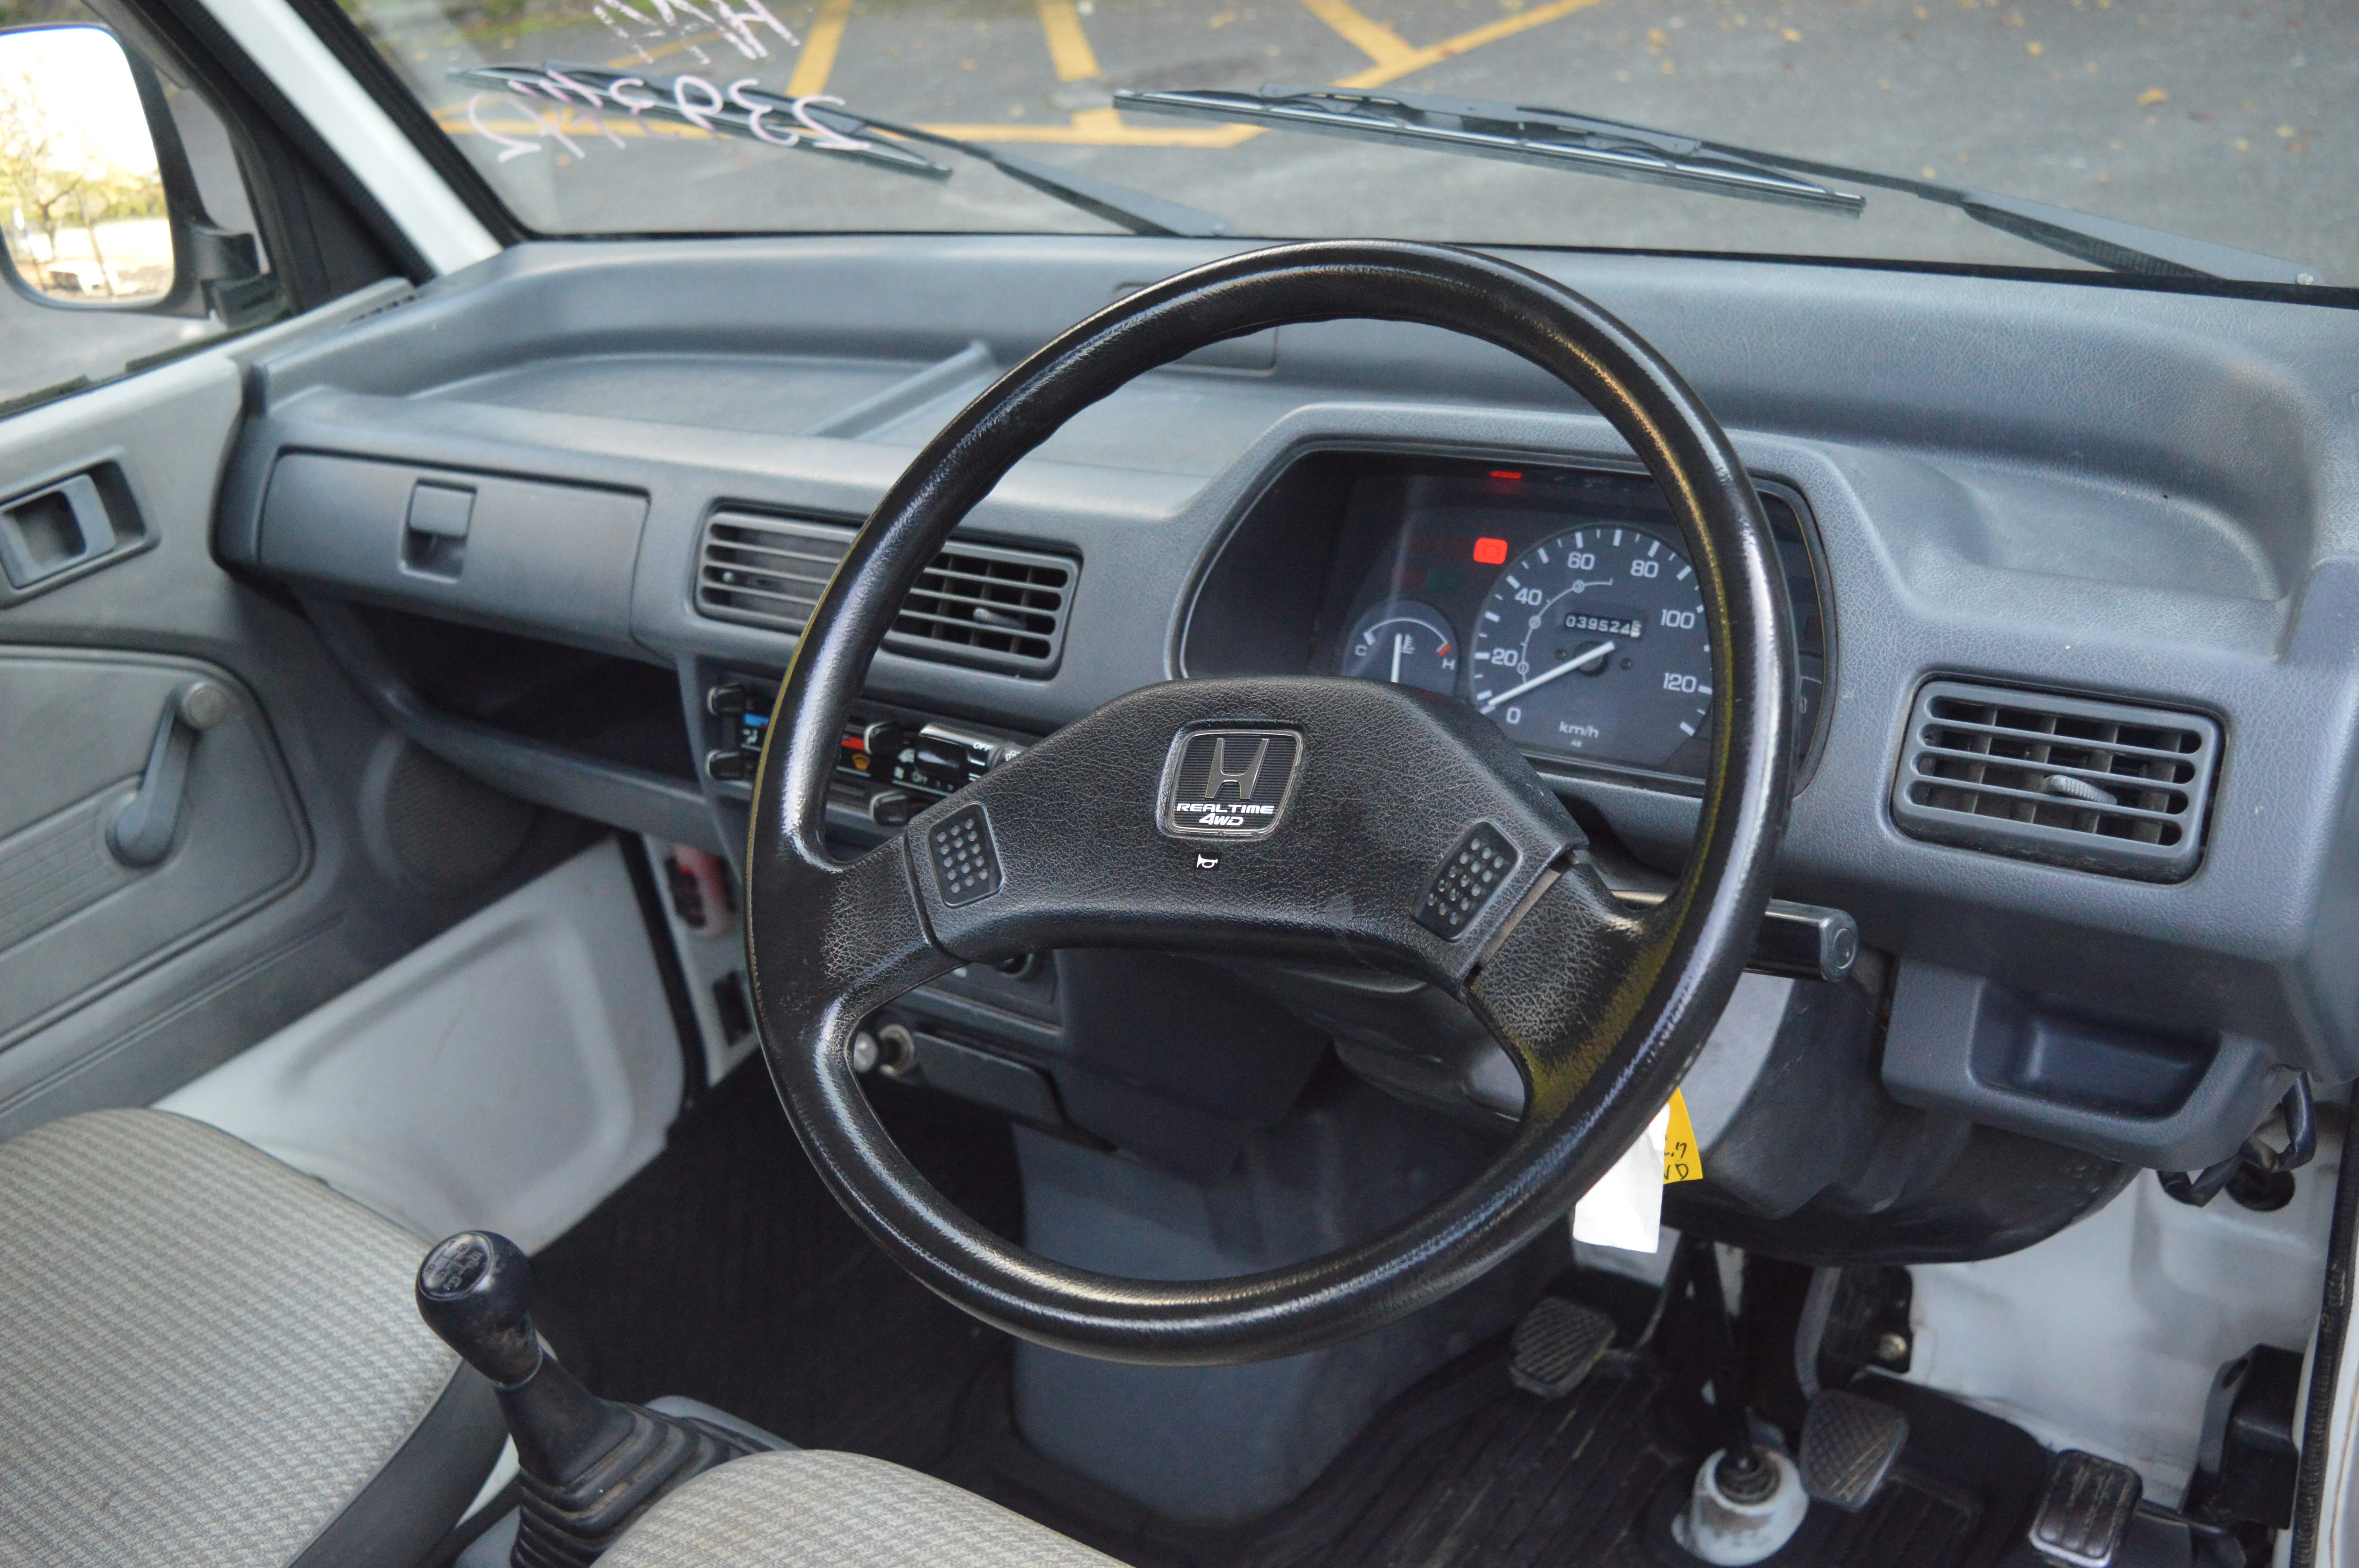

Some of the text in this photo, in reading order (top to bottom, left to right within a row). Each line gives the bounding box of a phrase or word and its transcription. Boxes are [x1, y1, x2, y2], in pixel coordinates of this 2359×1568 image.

[1568, 553, 1594, 570] 60
[1631, 561, 1659, 578] 80
[1514, 588, 1543, 606] 40
[1660, 609, 1695, 629] 100
[1355, 644, 1367, 656] C
[1491, 649, 1518, 667] 20
[1442, 658, 1455, 670] H
[1663, 672, 1697, 692] 120
[1507, 708, 1521, 723] 0
[1559, 721, 1599, 738] km/h
[973, 742, 993, 751] OFF
[1199, 813, 1244, 826] 4WD
